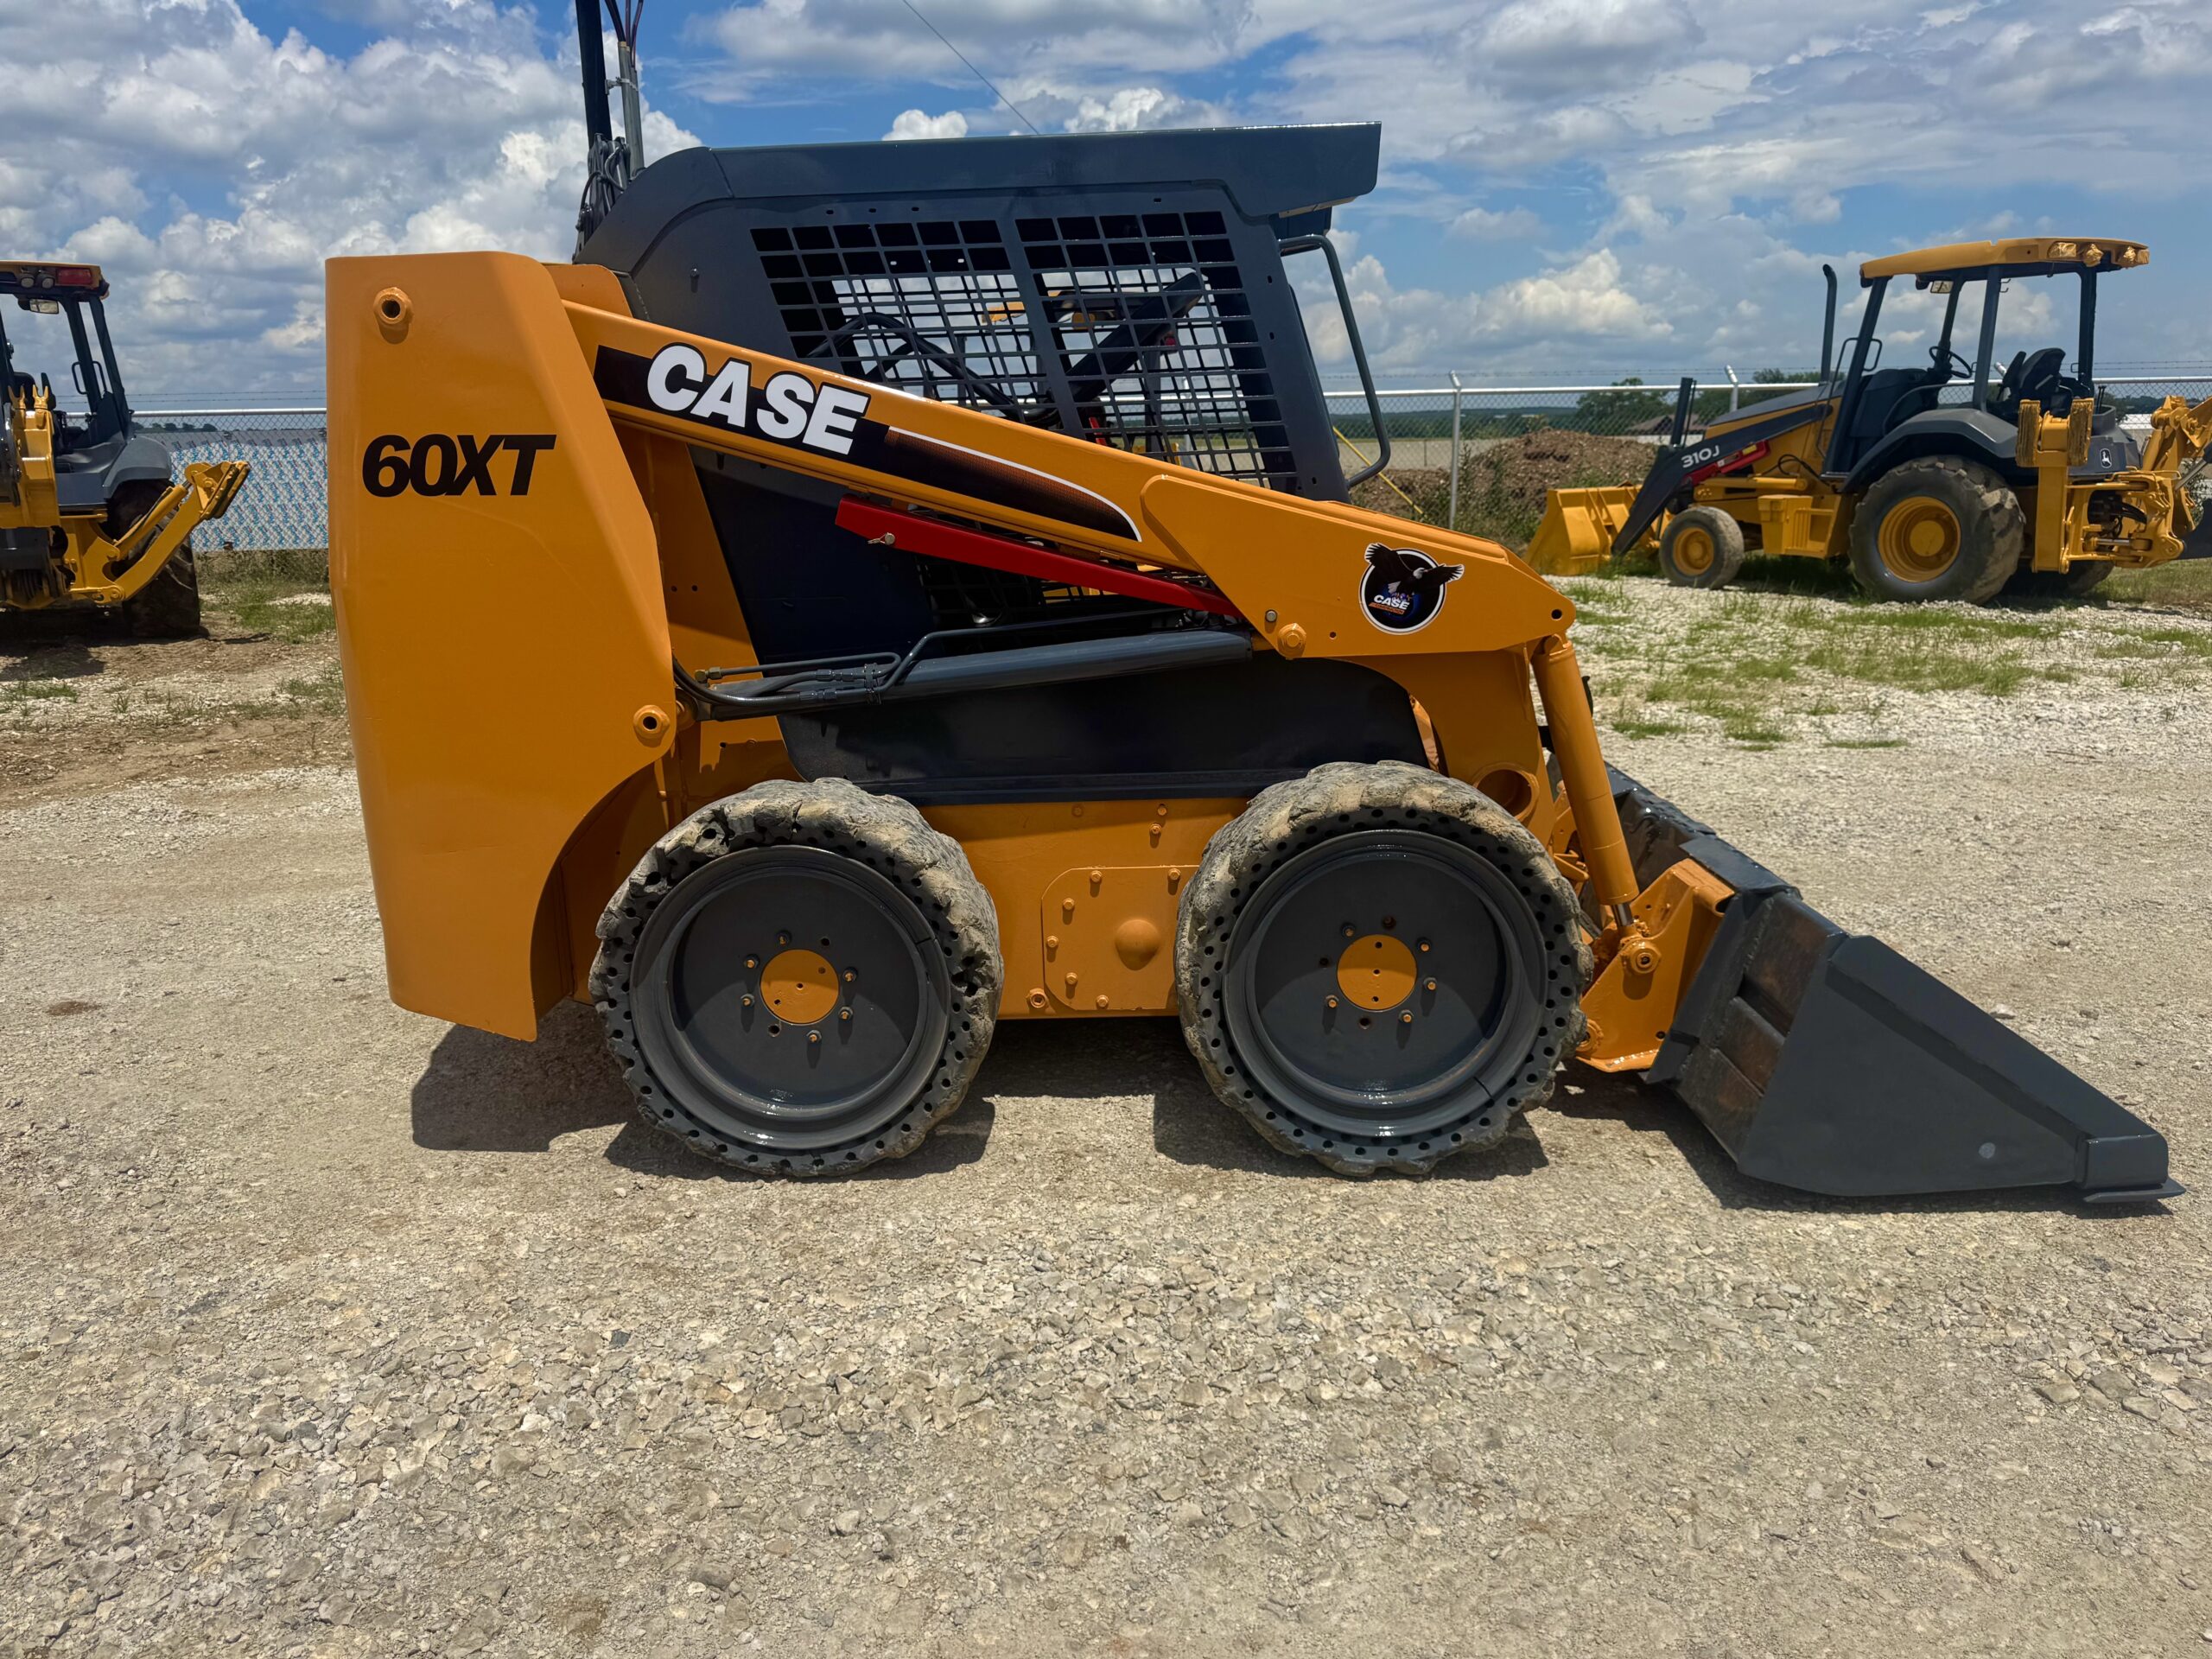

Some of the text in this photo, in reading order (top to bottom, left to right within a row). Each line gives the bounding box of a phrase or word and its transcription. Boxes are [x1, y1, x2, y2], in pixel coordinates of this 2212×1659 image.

[647, 345, 869, 454] CASE
[362, 435, 556, 497] 60XT
[1681, 445, 1719, 468] 310J
[1374, 594, 1409, 610] CASE
